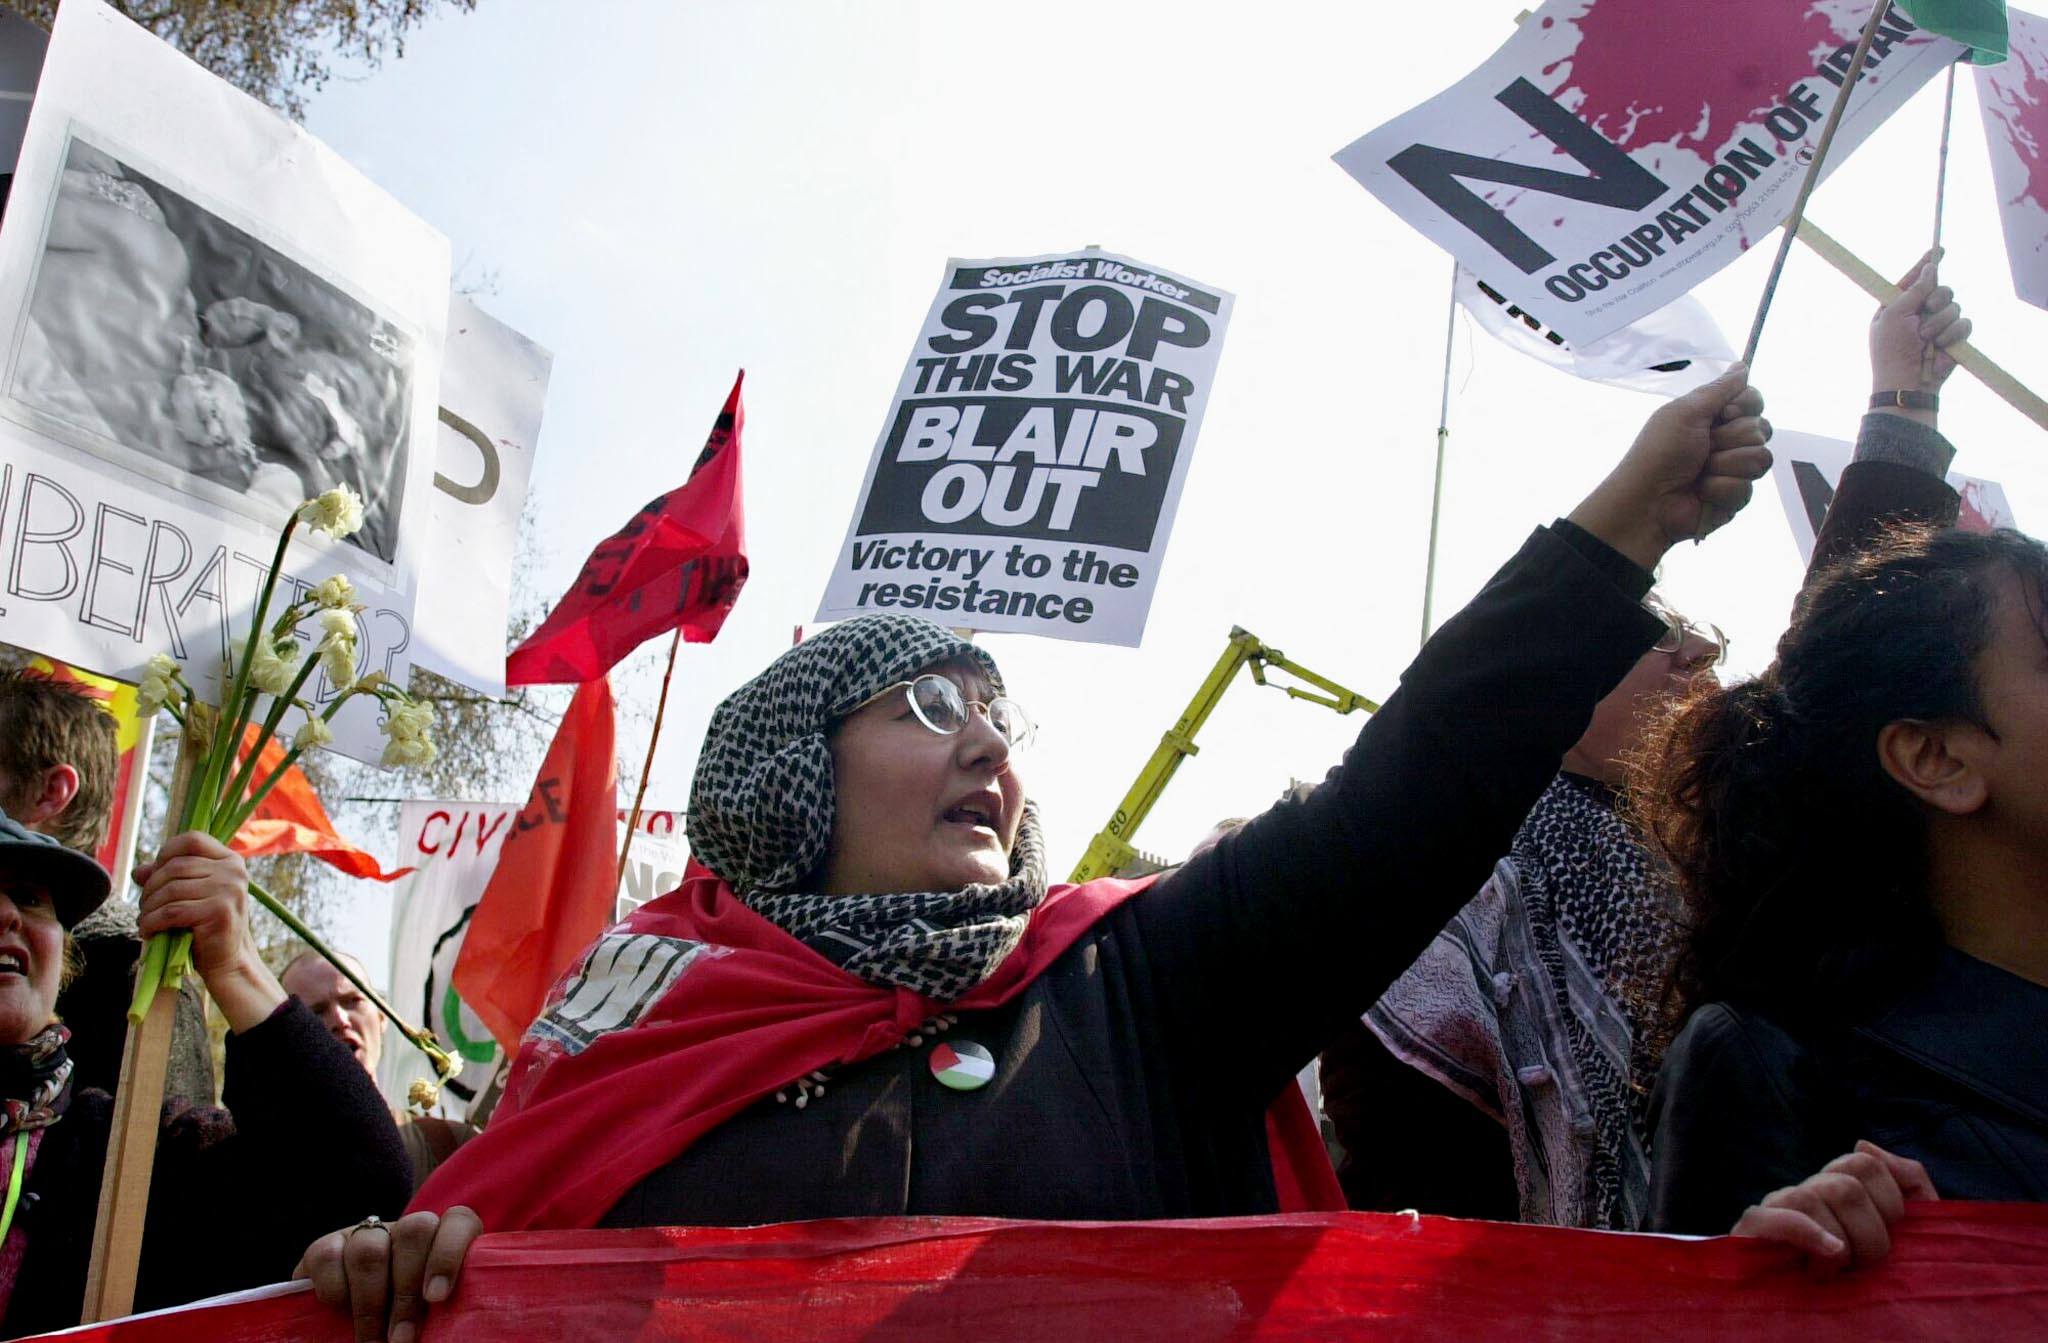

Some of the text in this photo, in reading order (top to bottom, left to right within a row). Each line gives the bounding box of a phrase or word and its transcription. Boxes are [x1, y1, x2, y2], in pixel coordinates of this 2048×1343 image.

[1545, 138, 1776, 302] OCCUPATION
[1764, 84, 1823, 141] OF
[979, 260, 1190, 300] Socialist Worker
[928, 284, 1211, 362] STOP
[913, 353, 1195, 414] THIS WAR
[896, 405, 1158, 476] BLAIR
[921, 463, 1101, 530] OUT
[851, 540, 1140, 589] Victory to the
[857, 577, 1094, 624] resistance
[1109, 810, 1127, 836] 80
